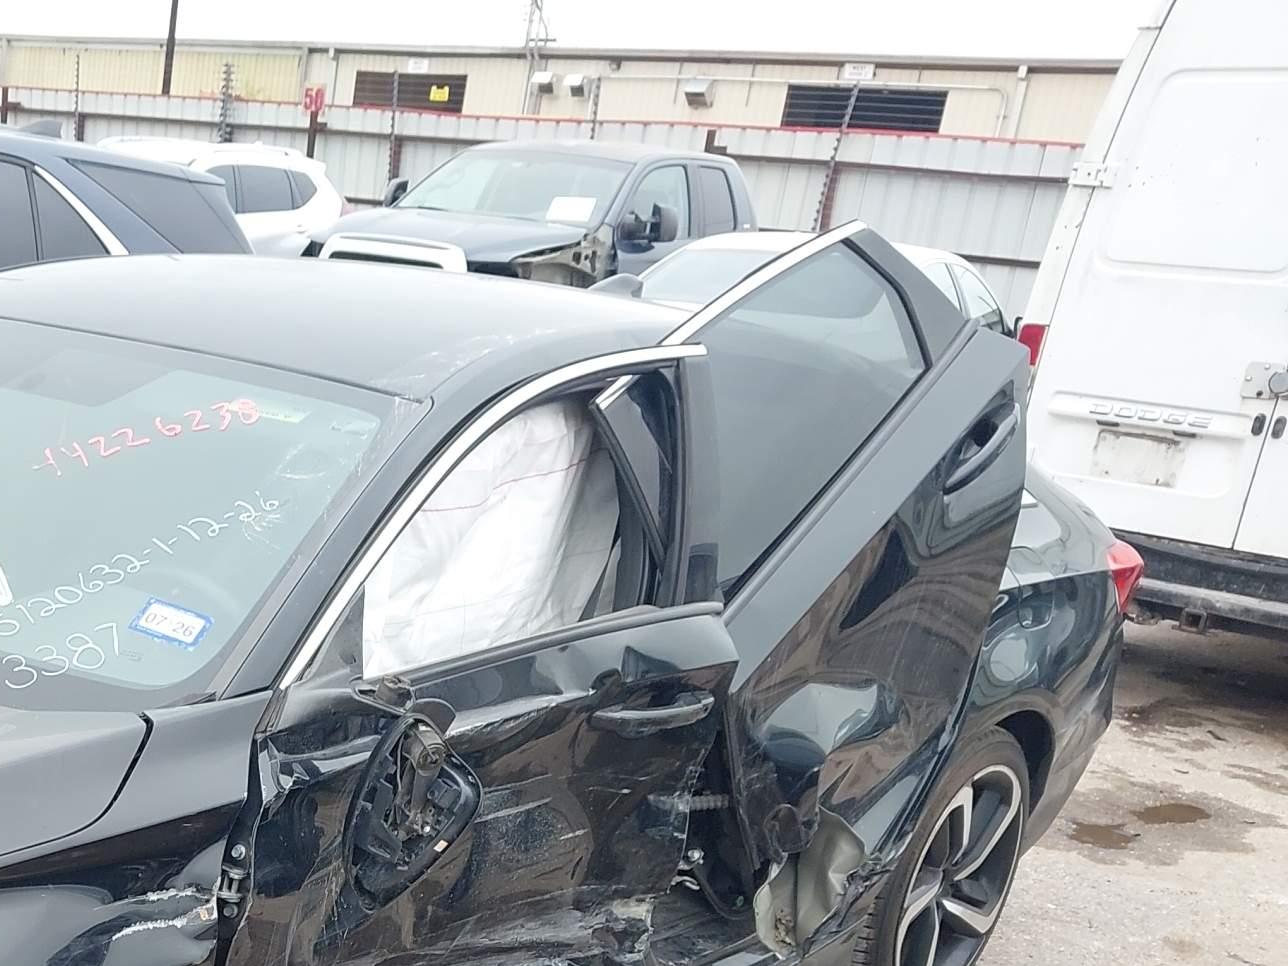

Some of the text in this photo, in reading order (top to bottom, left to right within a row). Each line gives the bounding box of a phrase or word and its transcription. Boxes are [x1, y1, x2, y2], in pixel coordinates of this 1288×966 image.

[304, 88, 324, 112] 50
[1089, 403, 1213, 429] DODGE
[1, 622, 120, 689] 3387
